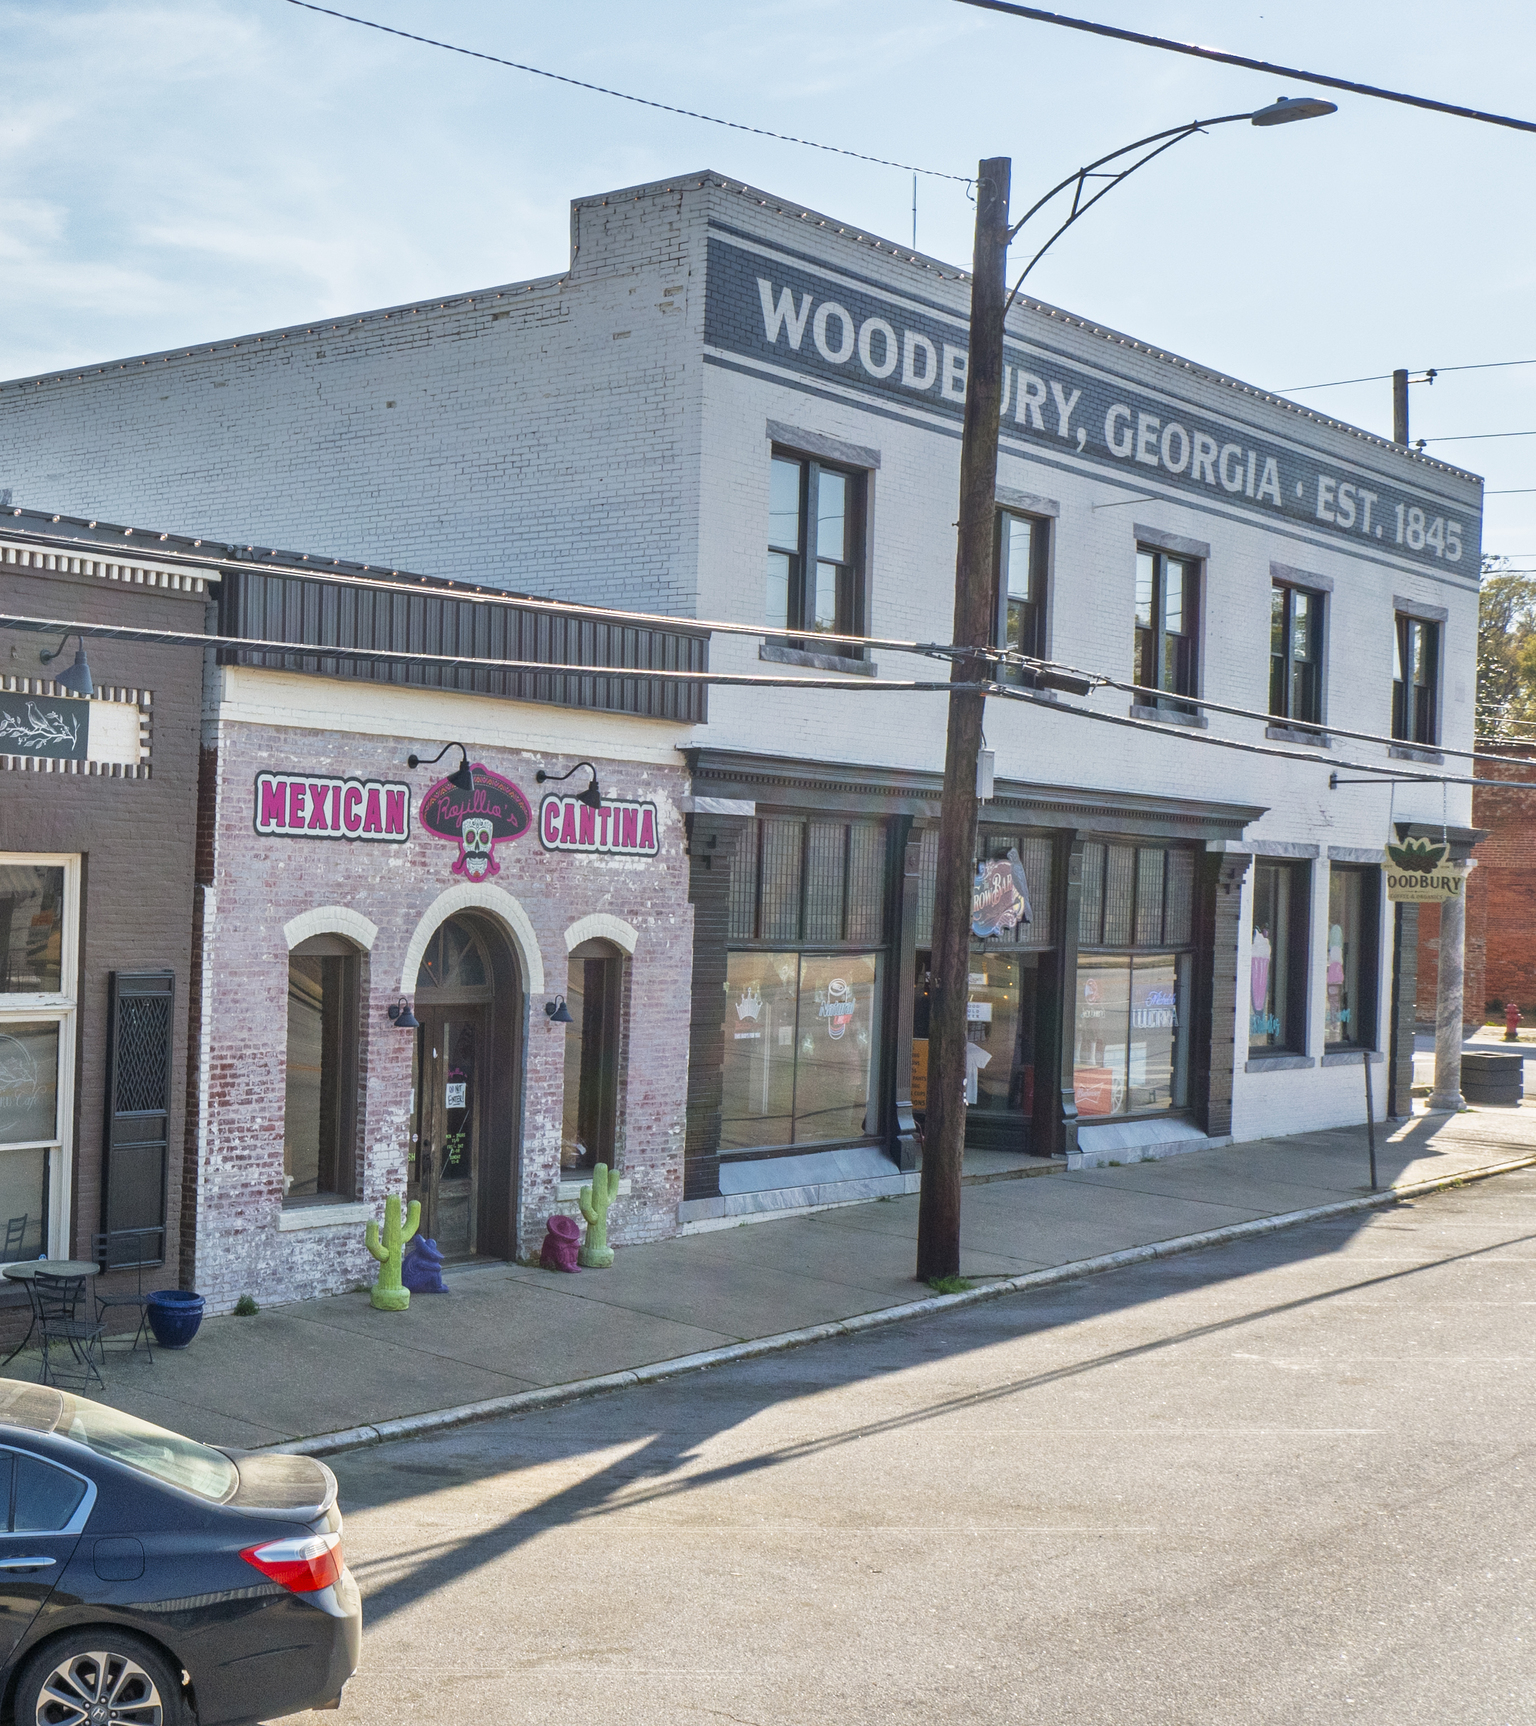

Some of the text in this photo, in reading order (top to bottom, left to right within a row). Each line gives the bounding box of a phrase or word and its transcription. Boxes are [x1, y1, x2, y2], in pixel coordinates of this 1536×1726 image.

[1104, 403, 1282, 507] GEORGIA
[1316, 474, 1383, 538] EST.
[1395, 502, 1463, 562] 1845
[260, 780, 406, 836] MEXICAN
[544, 801, 655, 849] CANTINA
[973, 888, 993, 912] ROW
[1387, 874, 1461, 895] OODBURY
